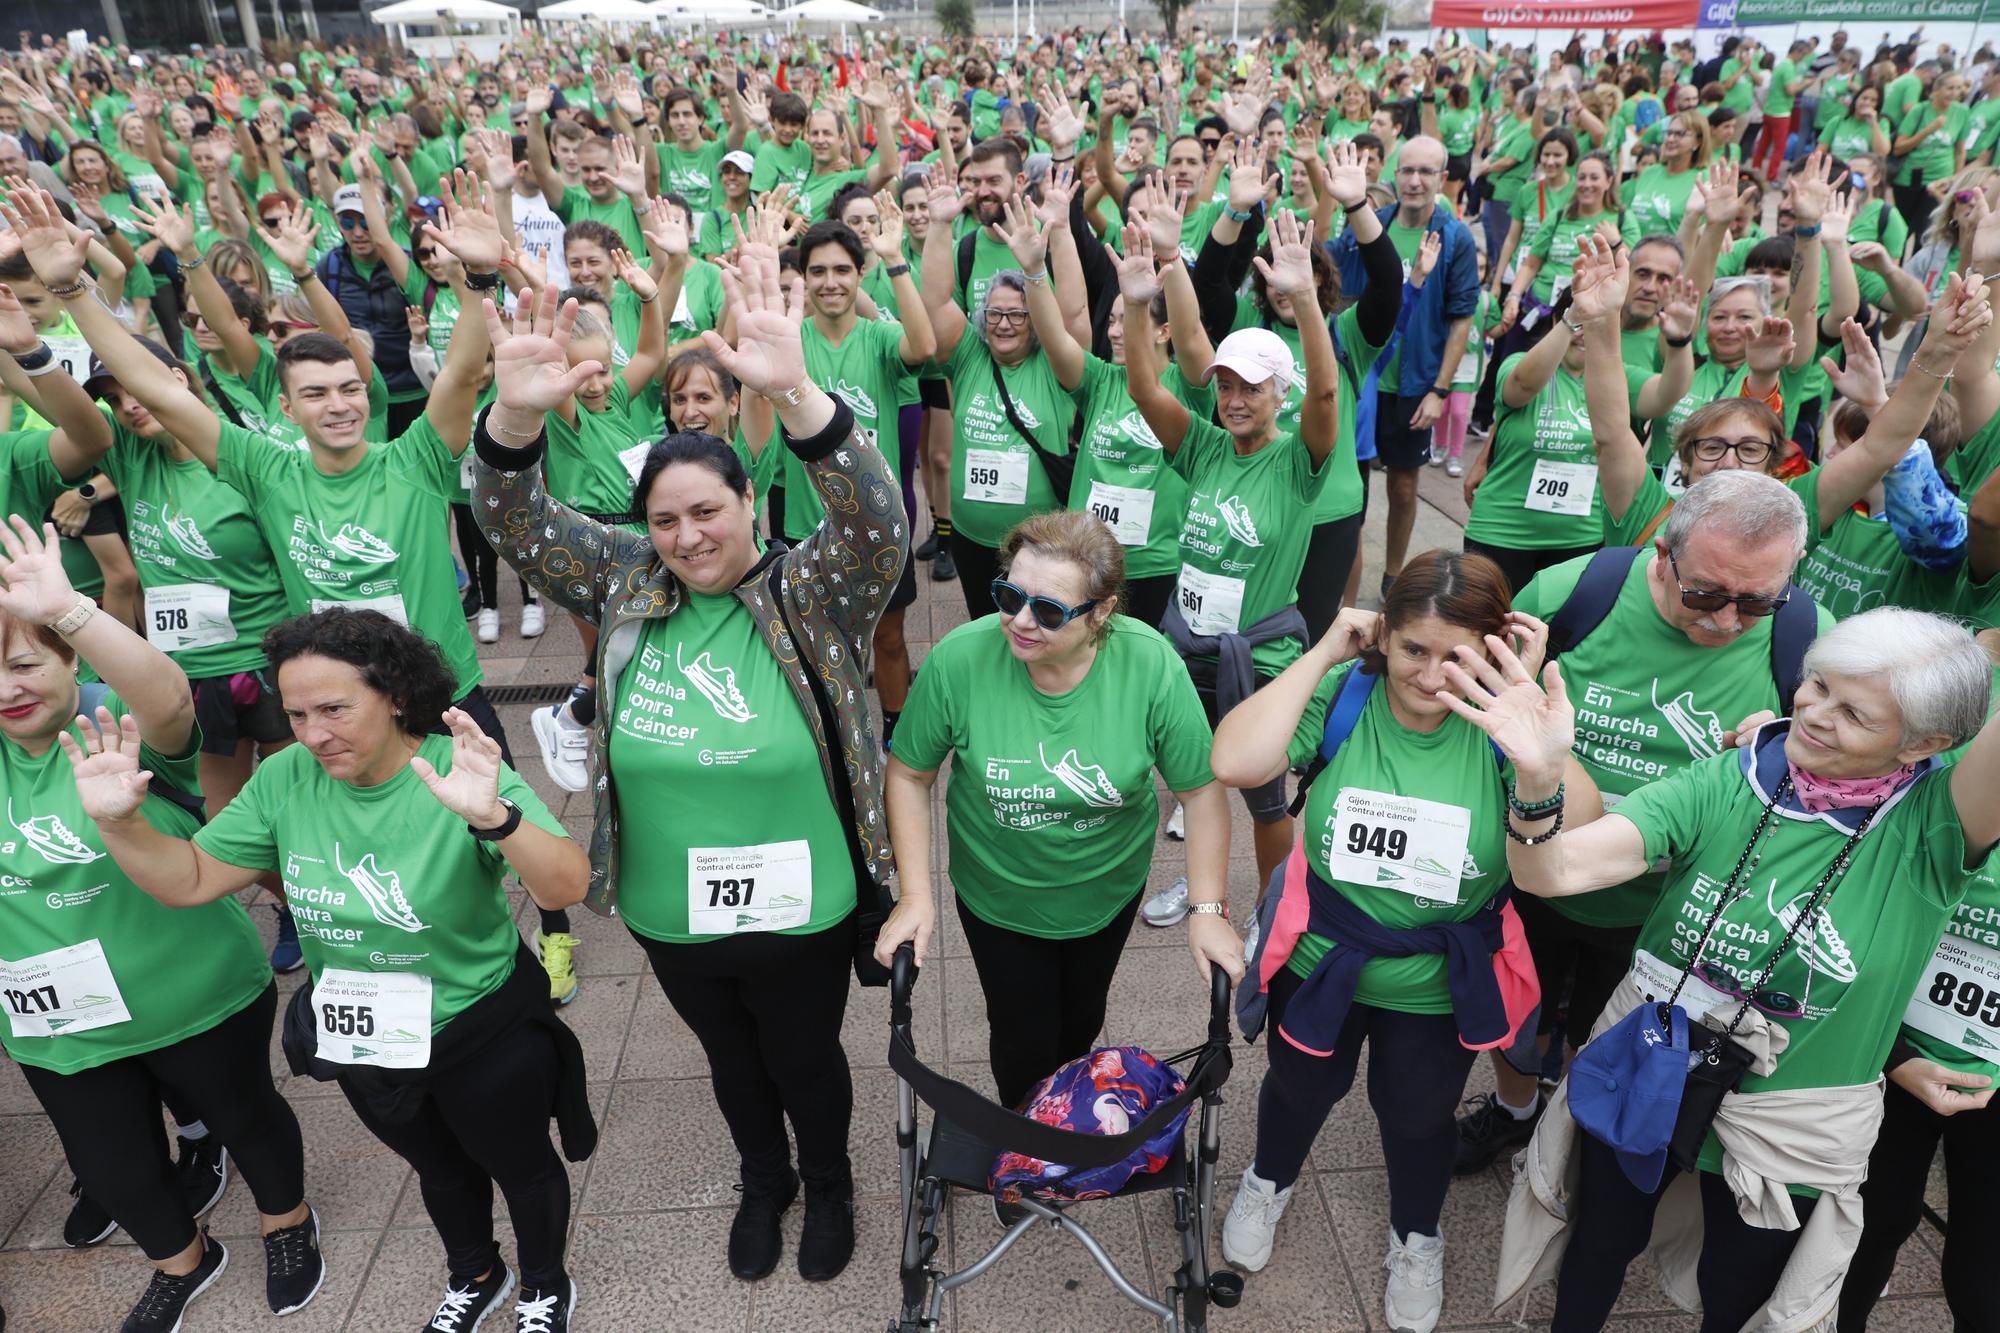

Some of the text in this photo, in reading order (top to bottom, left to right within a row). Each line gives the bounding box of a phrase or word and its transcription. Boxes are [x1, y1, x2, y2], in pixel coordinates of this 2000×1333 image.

[1482, 4, 1633, 25] GIJÓN ATLETISMO
[1806, 1, 1862, 17] Española
[1866, 2, 1910, 14] contra
[1912, 1, 1925, 14] el
[1928, 0, 1979, 15] Cáncer
[972, 395, 985, 407] En
[1673, 405, 1695, 416] mar
[967, 406, 1003, 421] marcha
[965, 416, 996, 431] contra
[974, 430, 1009, 442] cáncer
[1535, 429, 1574, 441] contra
[1533, 439, 1587, 451] el cáncer
[970, 467, 999, 485] 559
[1536, 478, 1569, 498] 209
[134, 502, 150, 518] En
[1092, 502, 1120, 525] 504
[1187, 510, 1217, 527] archa
[1182, 587, 1203, 615] 561
[155, 608, 189, 632] 578
[640, 647, 662, 673] En
[1584, 686, 1612, 709] En
[633, 717, 699, 740] cáncer
[1577, 708, 1659, 738] marcha
[1574, 727, 1642, 752] contra
[1574, 740, 1667, 777] el cáncer
[986, 762, 1010, 781] En
[986, 784, 1056, 799] marcha
[989, 798, 1046, 813] contra
[1348, 795, 1371, 807] Gijón
[1372, 800, 1384, 809] en
[1009, 811, 1071, 827] cáncer
[1347, 804, 1376, 817] contra
[1376, 808, 1385, 818] el
[1386, 811, 1417, 823] cáncer
[1347, 823, 1408, 861] 949
[696, 855, 719, 865] Gijón
[696, 861, 764, 872] contra el cáncer
[706, 878, 755, 907] 737
[1691, 878, 1721, 906] En
[289, 902, 333, 923] ontra
[1956, 903, 2000, 927] rch
[1675, 921, 1750, 962] contra
[1945, 919, 2000, 947] ntra
[1671, 938, 1689, 956] el
[1939, 941, 1985, 964] Gijón en
[13, 963, 48, 976] marcha
[1935, 951, 1985, 975] contra el
[20, 970, 51, 983] cáncer
[347, 979, 378, 988] marcha
[1653, 978, 1675, 994] cánce
[3, 985, 61, 1014] 1217
[351, 989, 379, 998] cáncer
[1928, 971, 2000, 1028] 895
[322, 1003, 375, 1037] 655
